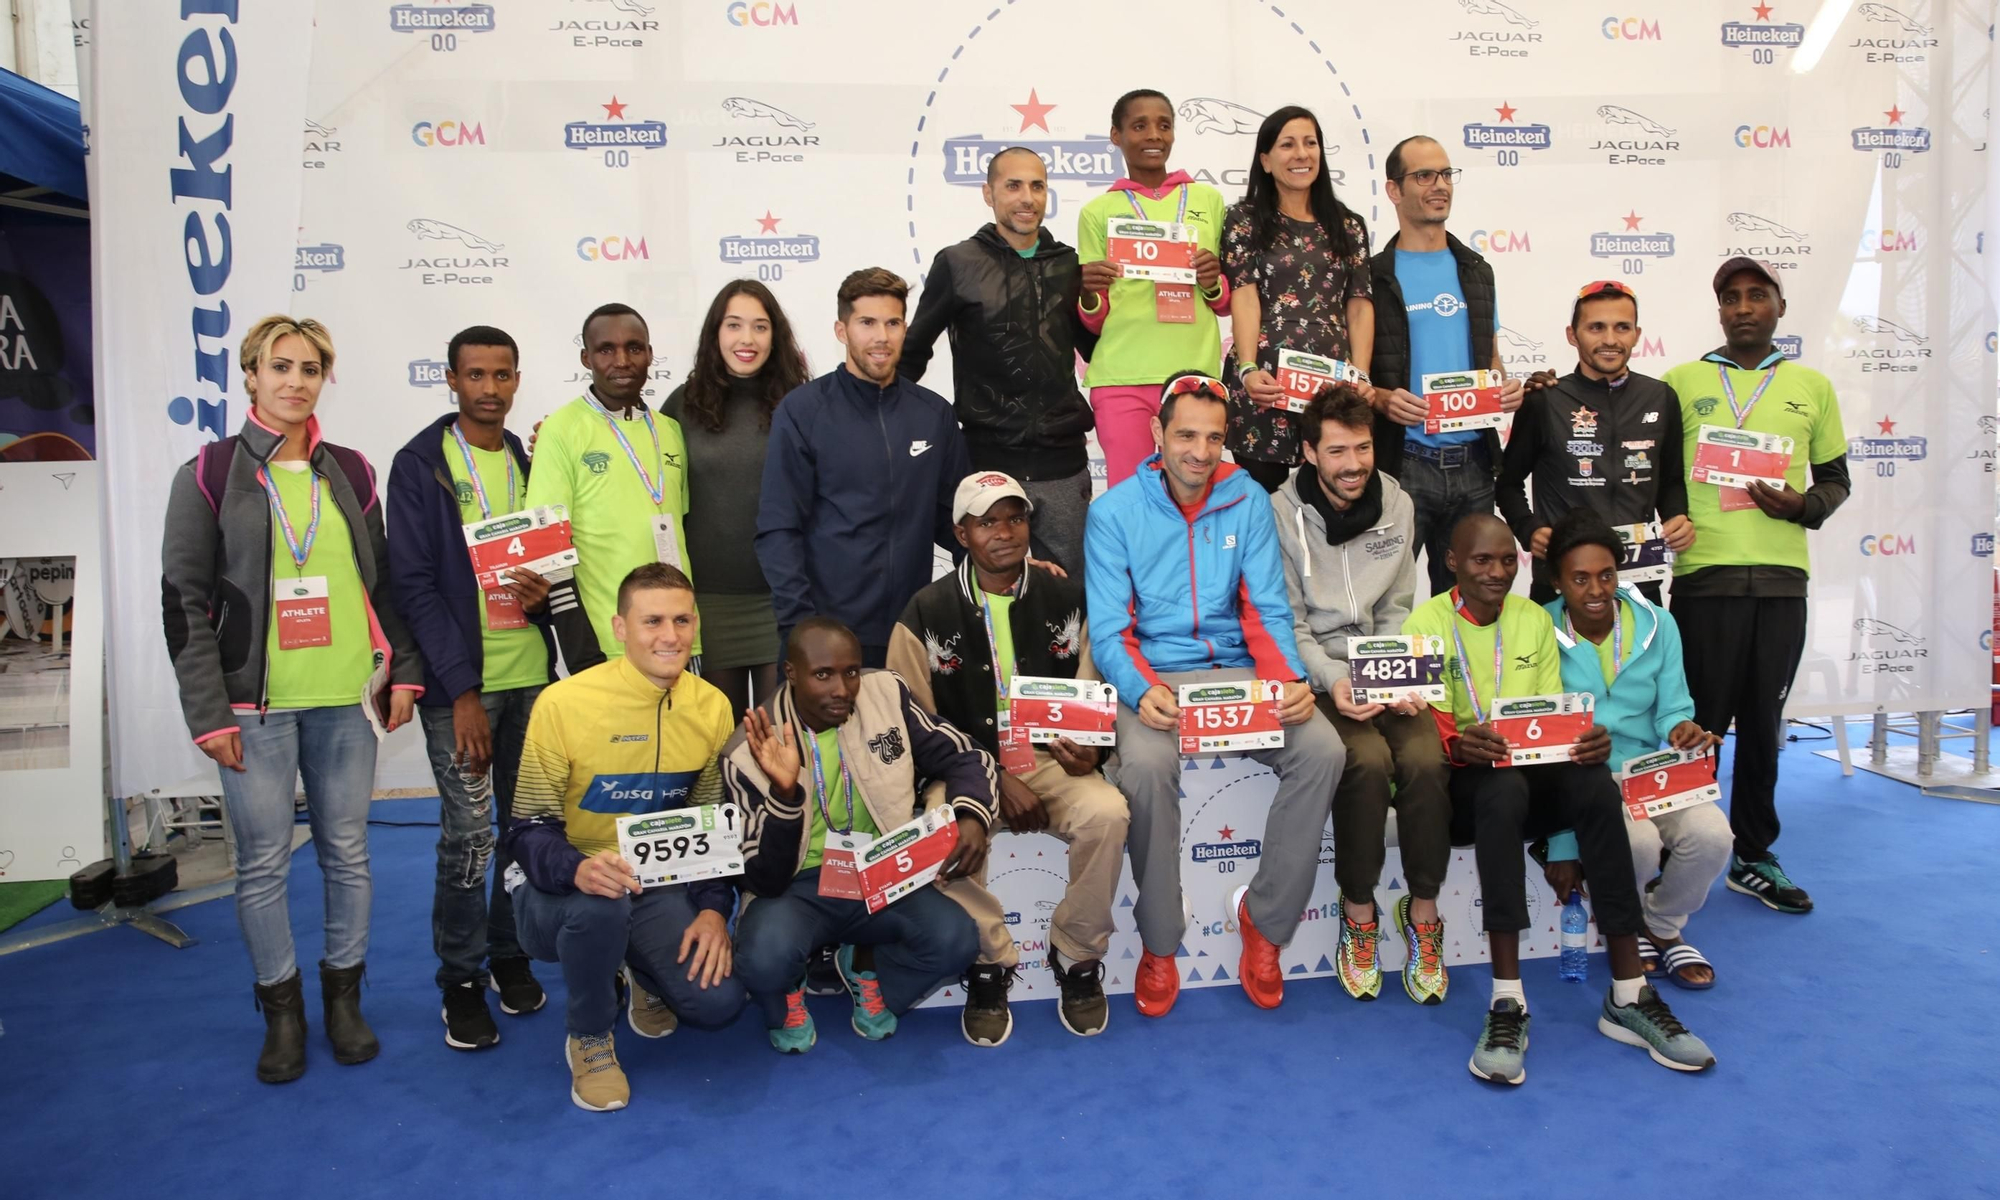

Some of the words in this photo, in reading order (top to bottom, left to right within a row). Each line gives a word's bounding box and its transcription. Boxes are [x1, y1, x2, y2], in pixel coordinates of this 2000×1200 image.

[396, 9, 489, 27] Heineken
[727, 2, 799, 27] GCM
[549, 20, 659, 31] JAGUAR
[1601, 17, 1662, 41] GCM
[574, 36, 643, 47] E-Pace
[1449, 32, 1542, 43] JAGUAR
[1726, 26, 1801, 43] Heineken
[431, 34, 457, 52] 0.0
[1849, 38, 1939, 49] JAGUAR
[1469, 46, 1529, 57] E-Pace
[1753, 49, 1774, 64] 0.0
[1867, 53, 1925, 63] E-Pace
[412, 121, 486, 147] GCM
[571, 126, 662, 145] Heineken
[712, 136, 820, 147] JAGUAR
[1468, 128, 1546, 145] Heineken
[1735, 125, 1791, 148] GCM
[1857, 131, 1926, 148] Heineken
[1589, 141, 1680, 151] JAGUAR
[604, 150, 630, 168] 0.0
[736, 152, 804, 163] E-Pace
[955, 144, 1115, 176] Heeken
[1497, 150, 1519, 167] 0.0
[1609, 155, 1666, 165] E-Pace
[1884, 152, 1902, 169] 0.0
[577, 236, 650, 261] GCM
[1469, 230, 1532, 253] GCM
[1595, 238, 1670, 253] Heineken
[725, 241, 814, 258] Heineken
[1133, 241, 1158, 260] 10
[1718, 245, 1811, 257] JAGUAR
[399, 258, 509, 269] JAGUAR
[1622, 259, 1644, 275] 0.0
[422, 273, 494, 285] E-Pace
[758, 263, 783, 281] 0.0
[1844, 348, 1932, 359] JAGUAR
[1861, 363, 1918, 373] E-Pace
[1440, 392, 1477, 411] 100
[1851, 441, 1922, 457] Heineken
[1730, 450, 1741, 467] 1
[593, 462, 606, 473] 42
[1876, 461, 1895, 477] 0.0
[539, 517, 545, 525] E
[507, 536, 526, 556] 4
[1365, 535, 1405, 553] SALMING
[1860, 534, 1916, 557] GCM
[488, 593, 516, 601] ATHLE
[281, 607, 326, 618] ATHLETE
[1845, 649, 1928, 661] JAGUAR
[1361, 658, 1417, 680] 4821
[1861, 663, 1915, 673] E-Pace
[1086, 691, 1092, 699] E
[1254, 690, 1259, 700] 1
[1047, 702, 1063, 722] 3
[1564, 703, 1570, 711] E
[1193, 705, 1255, 728] 1537
[1526, 719, 1542, 740] 6
[1687, 752, 1693, 760] E
[1654, 770, 1668, 790] 9
[662, 787, 689, 799] HPS
[650, 817, 682, 827] cajasiete
[704, 819, 713, 827] 3
[926, 823, 933, 832] E
[633, 833, 710, 865] 9593
[1195, 844, 1258, 859] Heineken
[826, 858, 857, 868] ATHLET
[895, 850, 913, 873] 5
[1218, 860, 1236, 874] 0.0
